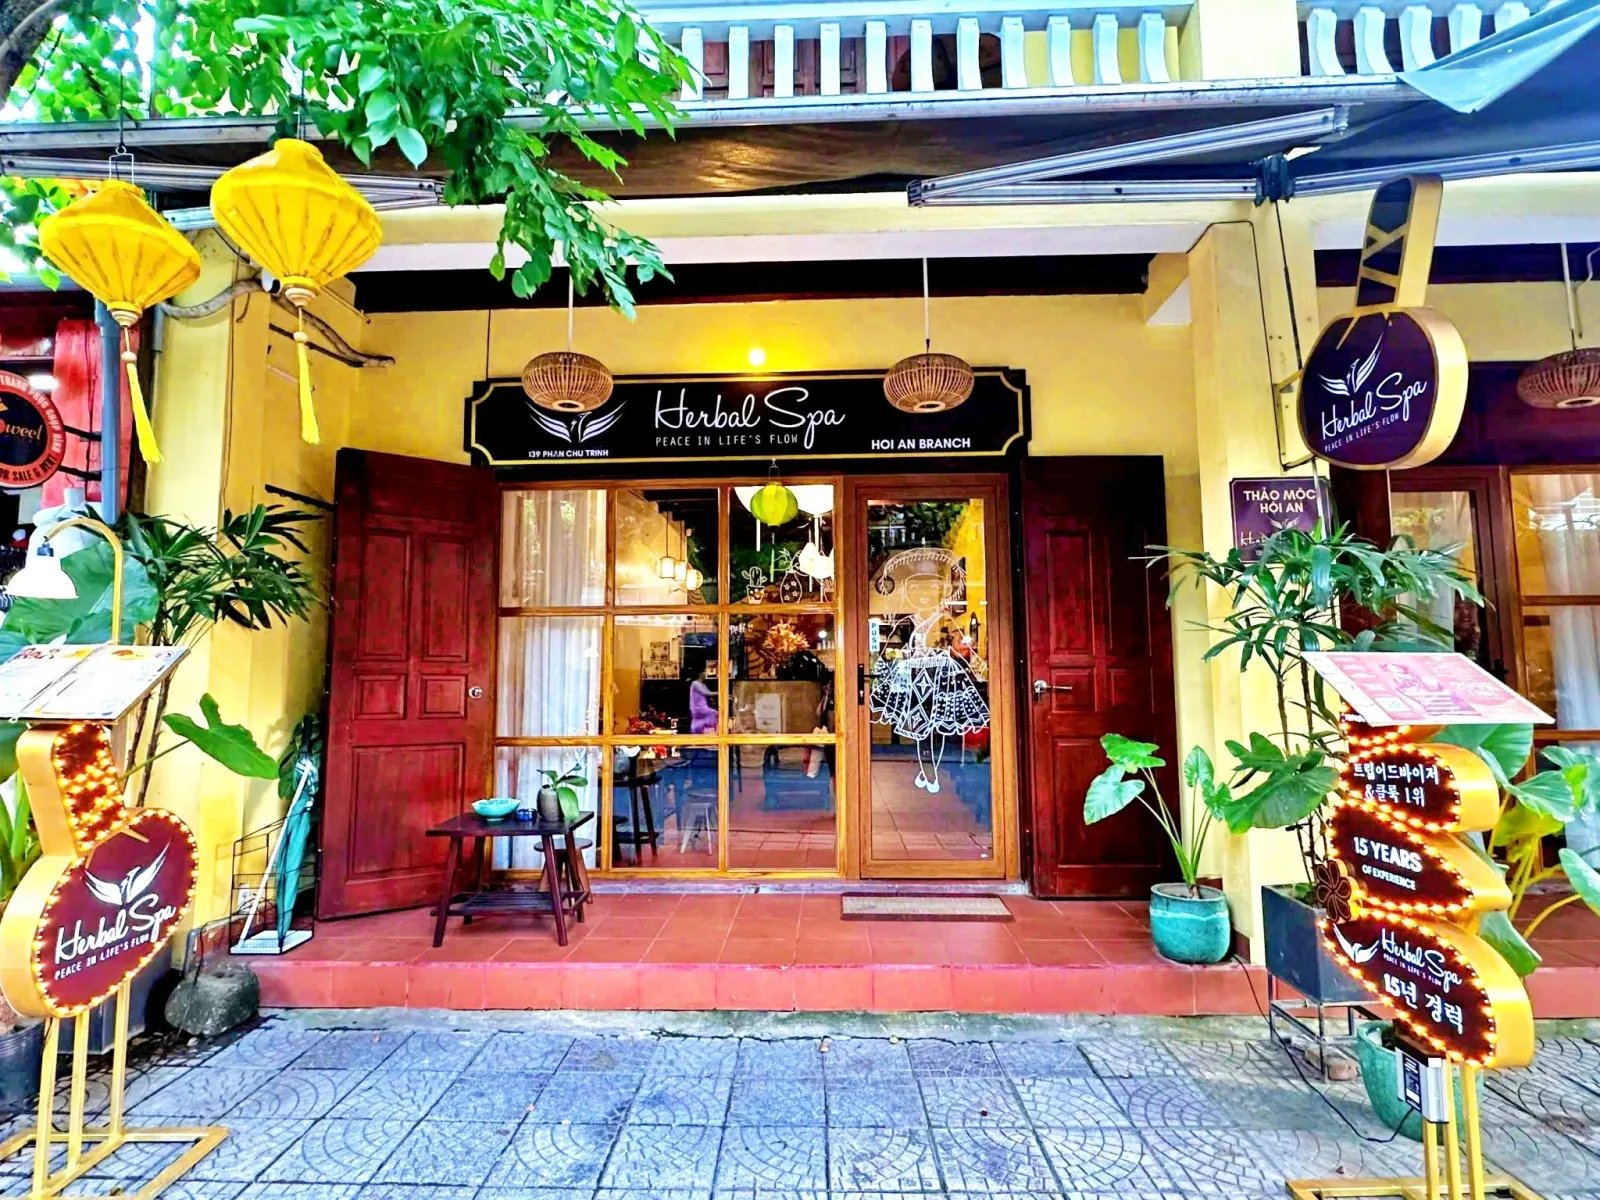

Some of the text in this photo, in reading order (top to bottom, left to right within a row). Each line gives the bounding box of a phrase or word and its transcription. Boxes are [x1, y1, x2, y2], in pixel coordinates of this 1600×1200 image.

[655, 386, 846, 449] Herbal Spa
[1321, 372, 1427, 440] Herbal Spa
[0, 419, 43, 440] weet
[655, 433, 799, 447] PEACE IN LIFE'S FLOW
[871, 438, 971, 450] HOI AN BRANCH
[1324, 411, 1400, 452] PEACE IN LIFE'S FLOW
[542, 450, 564, 458] PHAN
[585, 449, 609, 457] TRINH
[1285, 502, 1304, 513] AN
[1353, 836, 1424, 873] 15 YEARS
[1361, 864, 1417, 892] OF EXPERIENCE
[54, 893, 177, 965] Herbal Spa
[54, 932, 149, 981] PEACE IN LIFE'S FLOW
[1381, 927, 1463, 994] Herbal Spa
[1383, 972, 1464, 1036] 15년 경력
